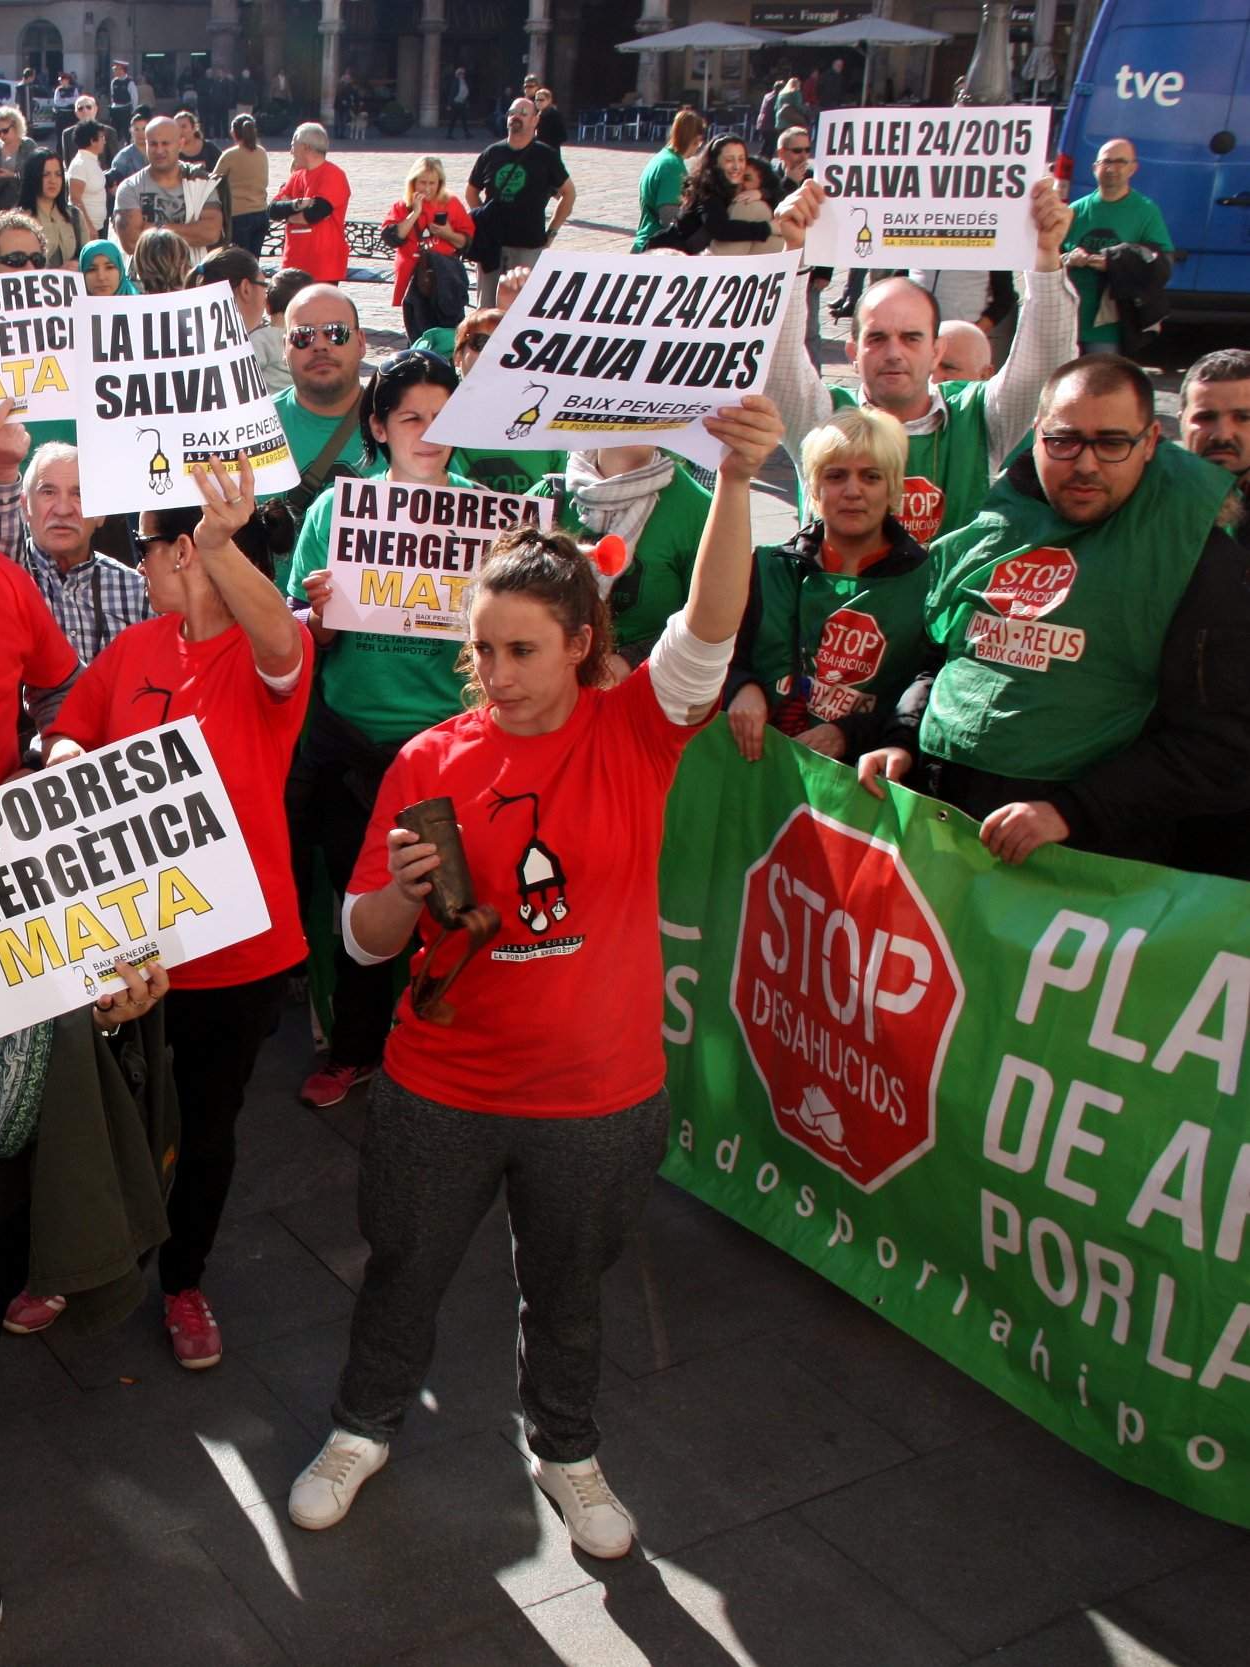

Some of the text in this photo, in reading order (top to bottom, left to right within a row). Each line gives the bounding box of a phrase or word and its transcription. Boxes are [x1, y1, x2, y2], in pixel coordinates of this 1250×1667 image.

[1115, 64, 1184, 107] tve
[826, 119, 1032, 156] LA LLEI 24/2015
[824, 164, 1026, 198] SALVA VIDES
[883, 210, 998, 225] BAIX PENEDÉS
[528, 270, 786, 329] LA LLEI 24/2015
[91, 312, 135, 363] LA
[143, 305, 205, 360] LLEI
[500, 329, 764, 389] SALVA VIDES
[95, 366, 227, 420] SALVA
[563, 394, 712, 415] BAIX PENEDÉS
[182, 430, 230, 447] BAIX
[186, 448, 253, 461] ALIANA
[340, 482, 540, 530] LA POBRESA
[901, 492, 940, 517] TOP
[337, 529, 494, 571] ENERGÈTI
[359, 569, 473, 613] MAT
[1001, 560, 1072, 589] STOP
[822, 622, 878, 656] STOP
[977, 644, 1046, 669] BAIX CAMP
[1020, 625, 1081, 659] REUS
[817, 648, 872, 674] ESAHUCIOS
[93, 960, 112, 971] BAIX
[760, 862, 934, 1044] STOP
[1015, 908, 1250, 1096] PLA
[752, 976, 907, 1127] DESAHUCIOS
[983, 1053, 1124, 1206] DE
